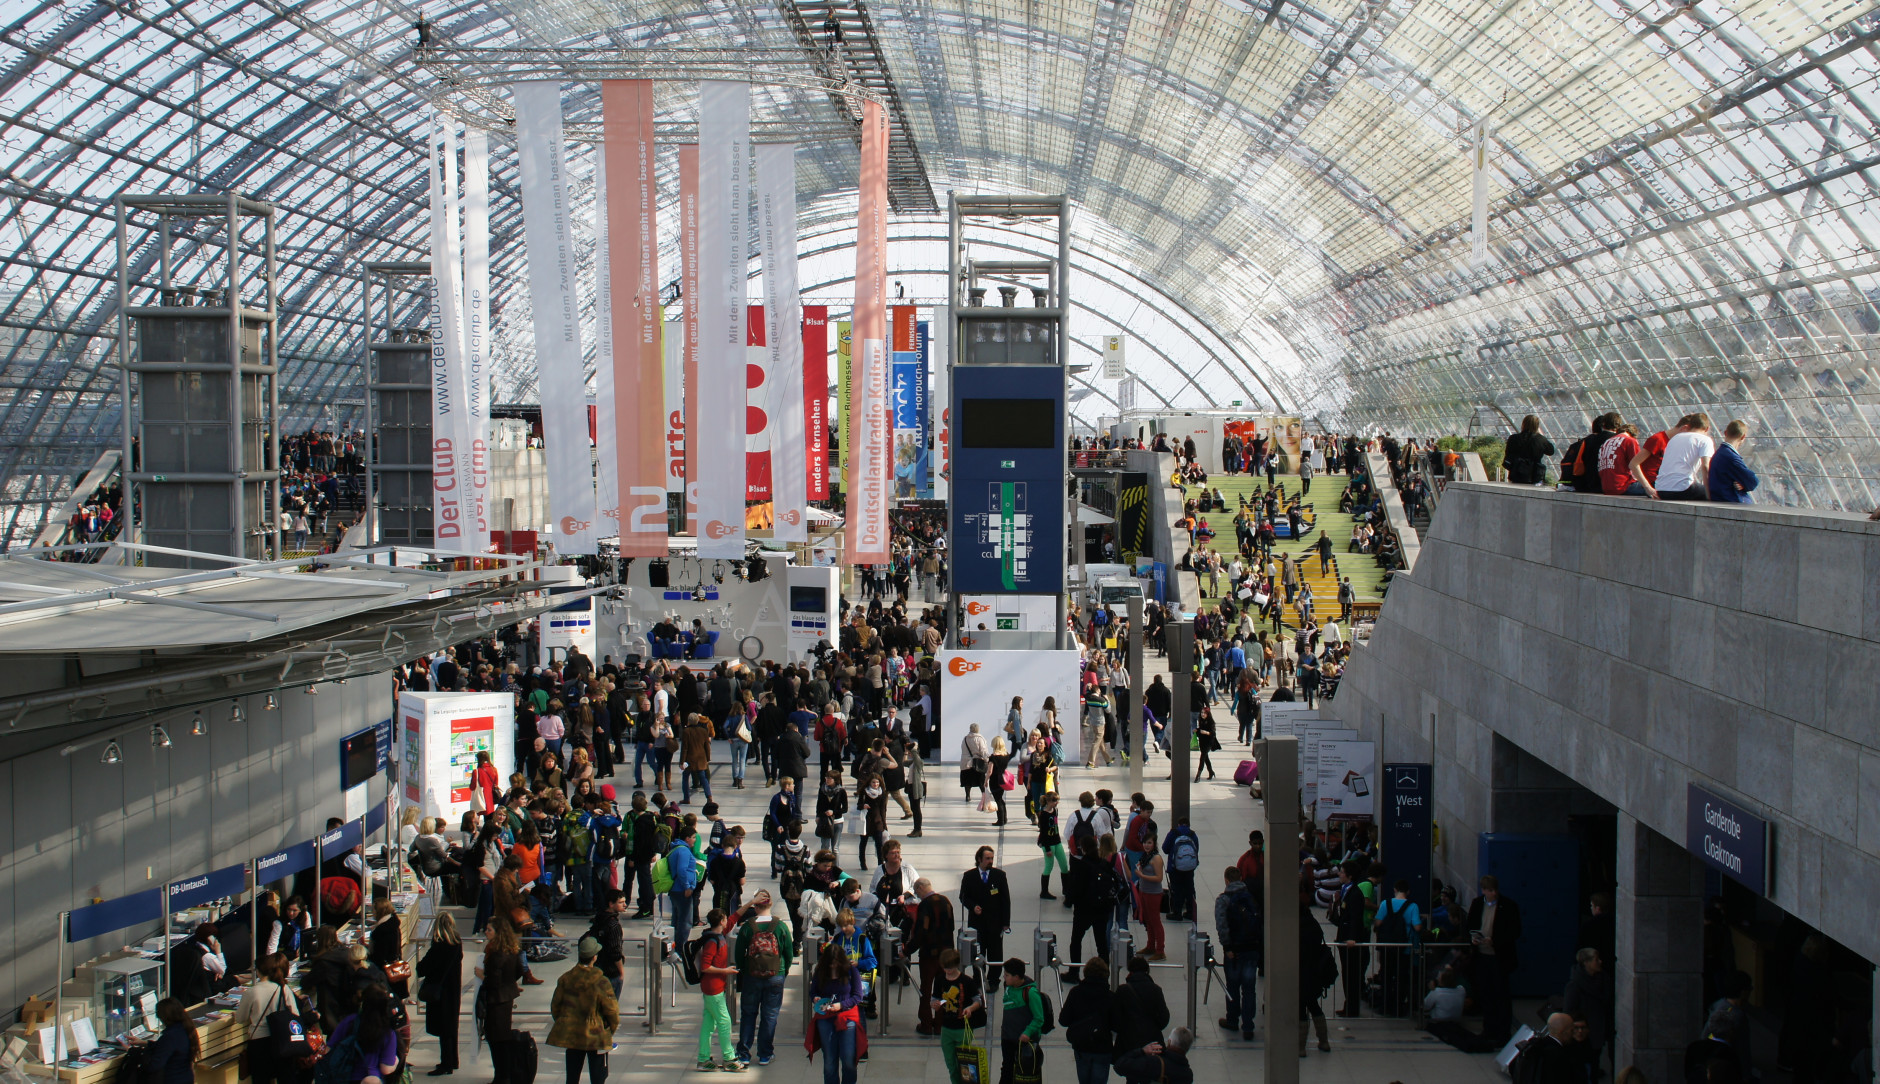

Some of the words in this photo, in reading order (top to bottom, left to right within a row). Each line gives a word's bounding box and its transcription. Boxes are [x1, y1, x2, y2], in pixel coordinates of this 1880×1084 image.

[549, 141, 560, 181] besser
[637, 140, 648, 181] besser
[730, 140, 742, 183] besser
[552, 184, 561, 207] man
[640, 184, 649, 208] man
[731, 184, 741, 208] man
[554, 209, 565, 241] sieht
[639, 209, 650, 241] sieht
[728, 209, 740, 241] sieht
[559, 245, 570, 292] Zweiten
[641, 244, 652, 292] Zweiten
[729, 244, 739, 292] Zweiten
[563, 295, 572, 321] dem
[644, 295, 653, 321] dem
[728, 295, 739, 321] dem
[564, 325, 574, 342] Mit
[644, 325, 653, 344] Mit
[729, 324, 739, 344] Mit
[867, 346, 883, 399] Kultur
[811, 399, 821, 452] fernsehen
[667, 410, 685, 478] arte
[433, 438, 457, 492] Club
[814, 455, 822, 493] anders
[861, 403, 882, 545] Deutschlandradio
[462, 453, 475, 520] BERTELSMANN
[438, 497, 461, 539] Der
[1395, 806, 1400, 817] 1
[1396, 795, 1423, 806] West
[1704, 802, 1741, 840] Garderobe
[321, 830, 343, 847] Information
[1704, 834, 1741, 874] Cloakroom
[258, 853, 288, 870] Information
[170, 876, 209, 896] DB-Umtausch
